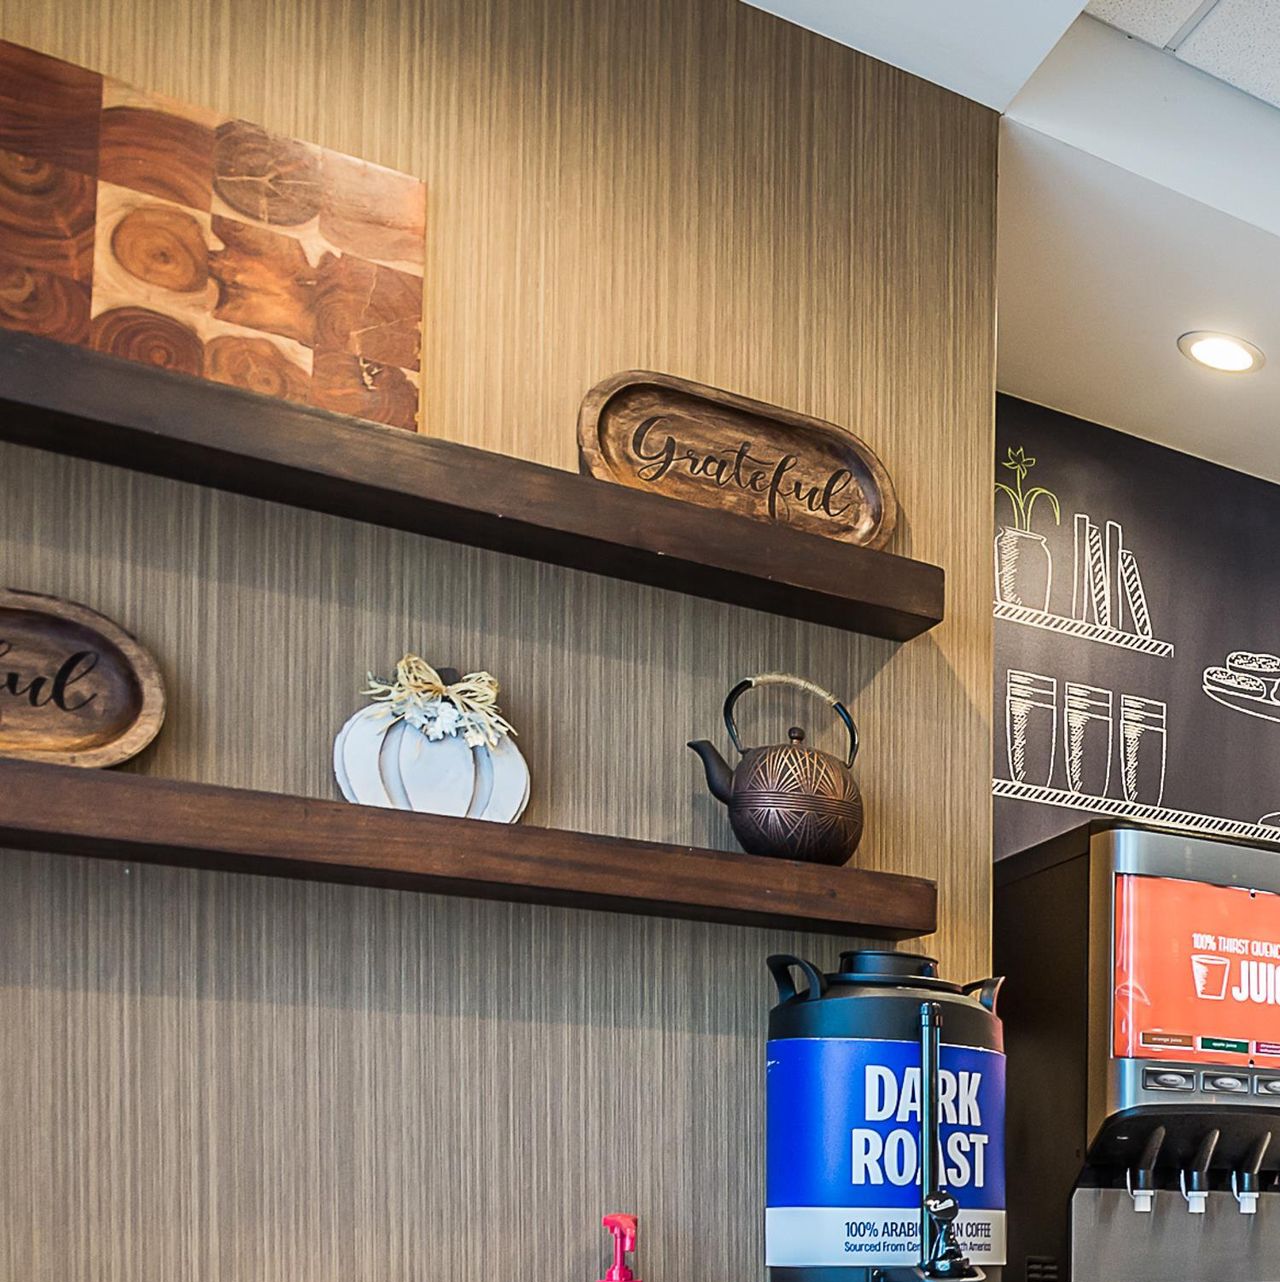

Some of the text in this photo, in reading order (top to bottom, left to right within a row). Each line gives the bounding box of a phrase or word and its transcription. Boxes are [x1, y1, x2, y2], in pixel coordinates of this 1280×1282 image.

[632, 416, 854, 521] Grateful
[1192, 933, 1217, 951] 100%
[1217, 936, 1250, 955] THIRST
[864, 1064, 982, 1126] DARK
[844, 1222, 921, 1237] 100% ARABI
[965, 1223, 991, 1238] COFFEE
[844, 1242, 881, 1252] Sourced
[883, 1242, 905, 1252] From
[969, 1242, 991, 1252] America
